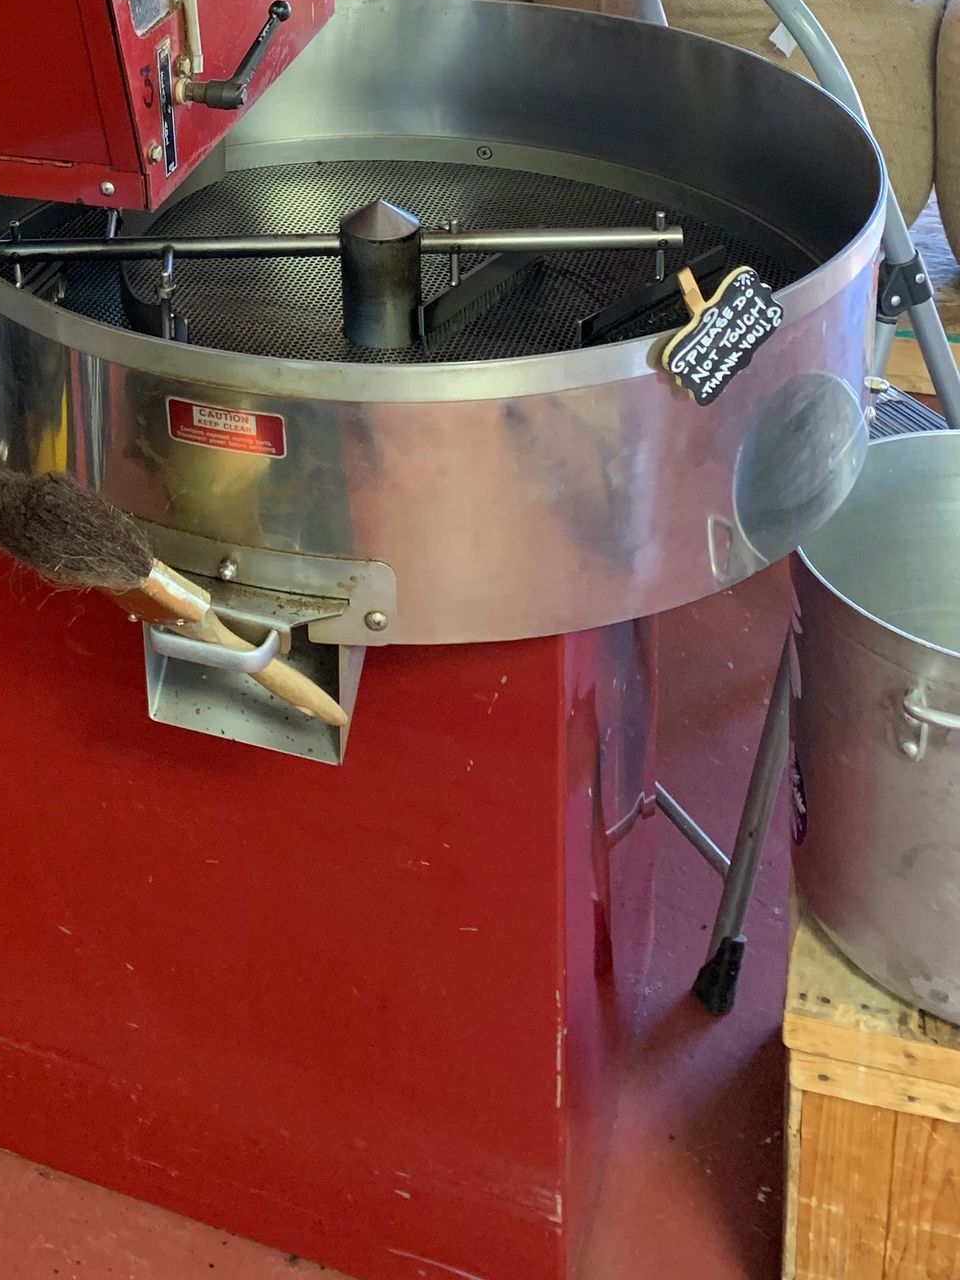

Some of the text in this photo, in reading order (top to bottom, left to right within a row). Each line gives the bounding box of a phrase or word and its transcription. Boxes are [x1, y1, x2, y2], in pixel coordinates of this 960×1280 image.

[685, 288, 754, 365] PLEASE DO
[691, 296, 767, 384] NOT TOUCH
[702, 319, 772, 394] THANK YOU!
[197, 419, 252, 433] KEEP CLEAR
[199, 408, 249, 424] CAUTION
